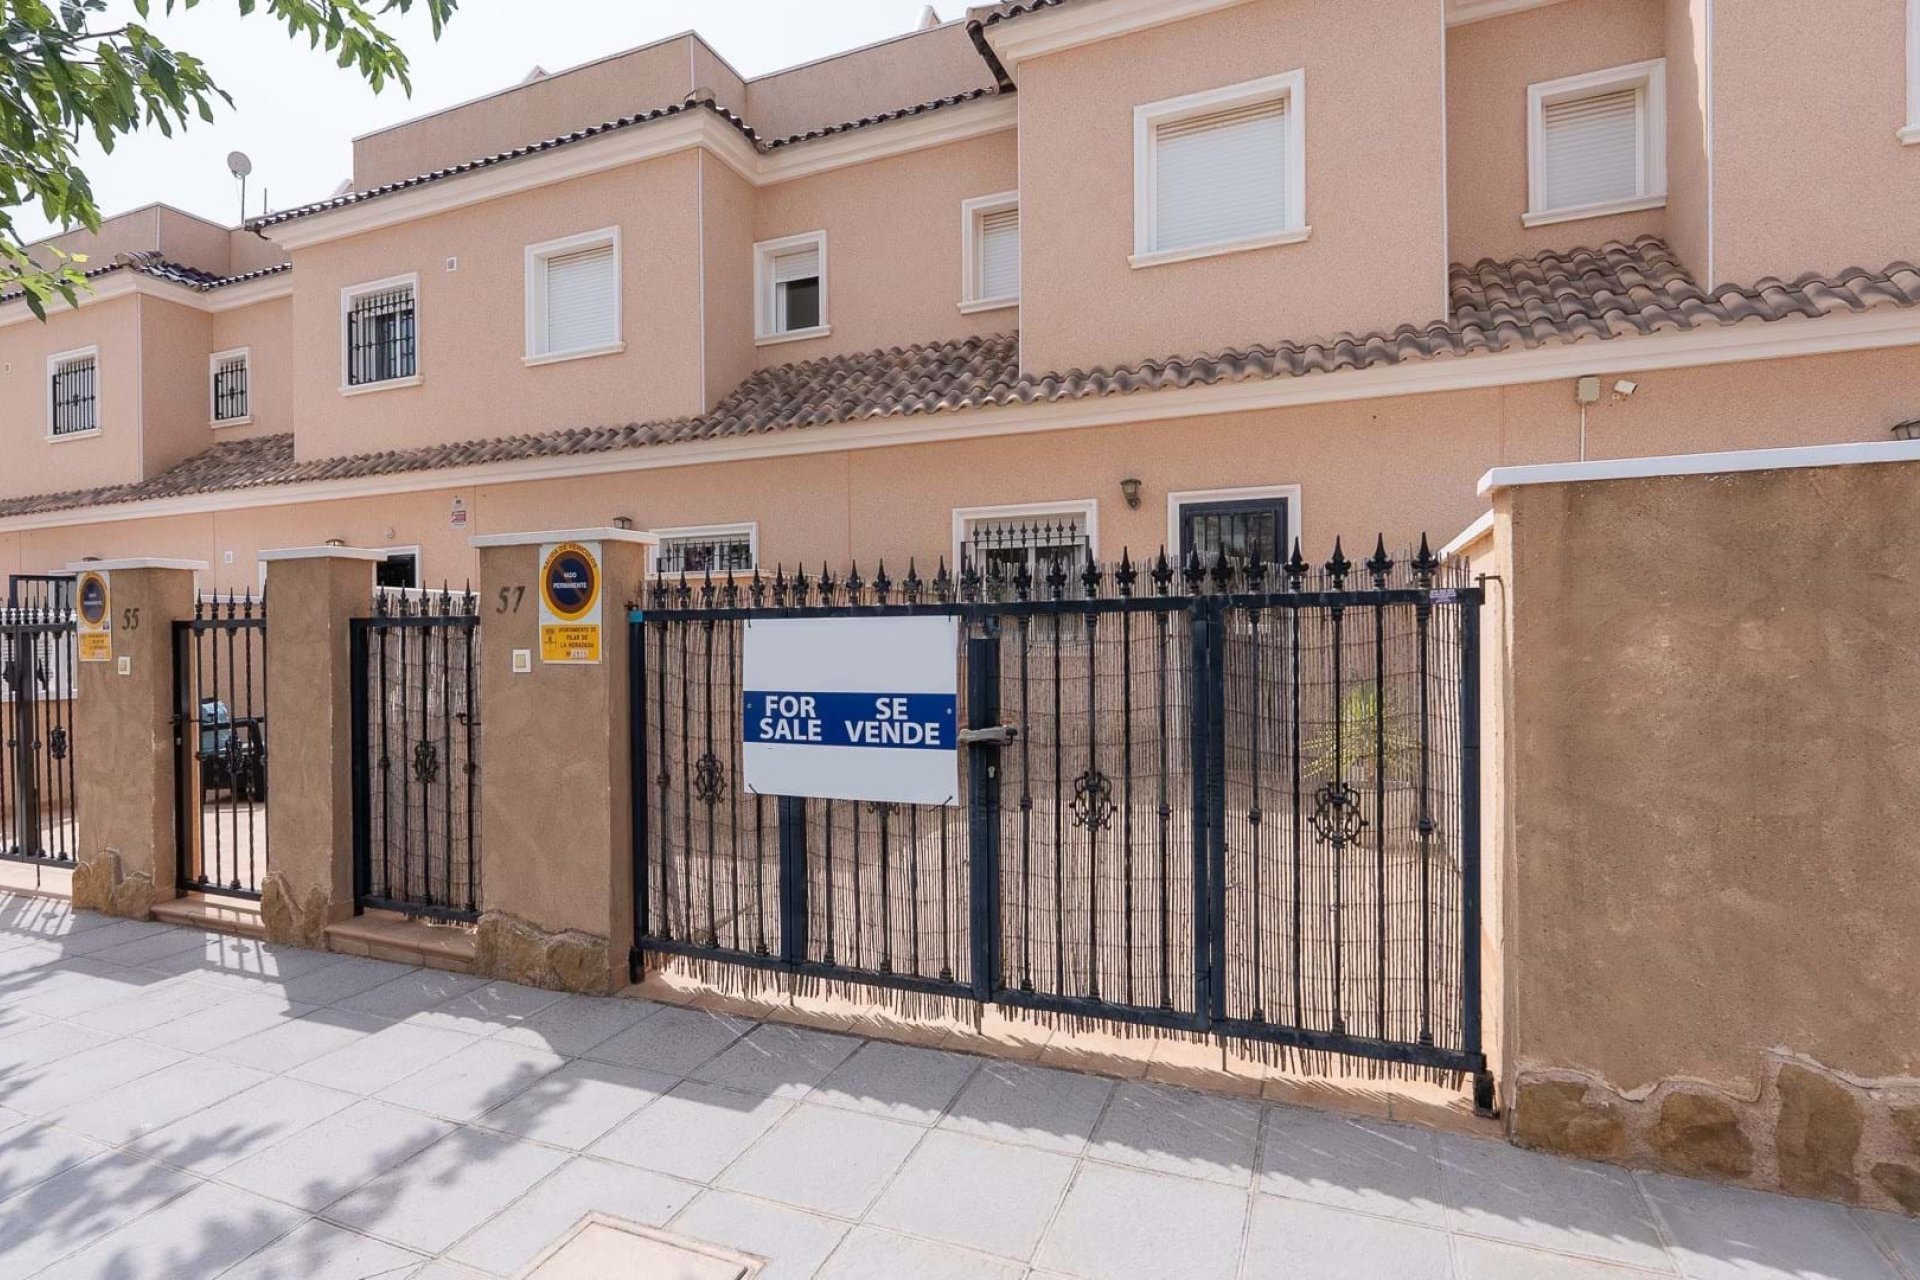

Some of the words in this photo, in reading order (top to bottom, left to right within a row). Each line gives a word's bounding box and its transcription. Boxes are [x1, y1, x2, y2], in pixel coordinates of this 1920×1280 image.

[552, 581, 587, 589] PERMANENTE
[496, 585, 525, 614] 57
[122, 607, 140, 630] 55
[765, 695, 817, 718] FOR
[875, 697, 908, 720] SE
[759, 718, 822, 742] SALE
[844, 720, 941, 746] VENDE
